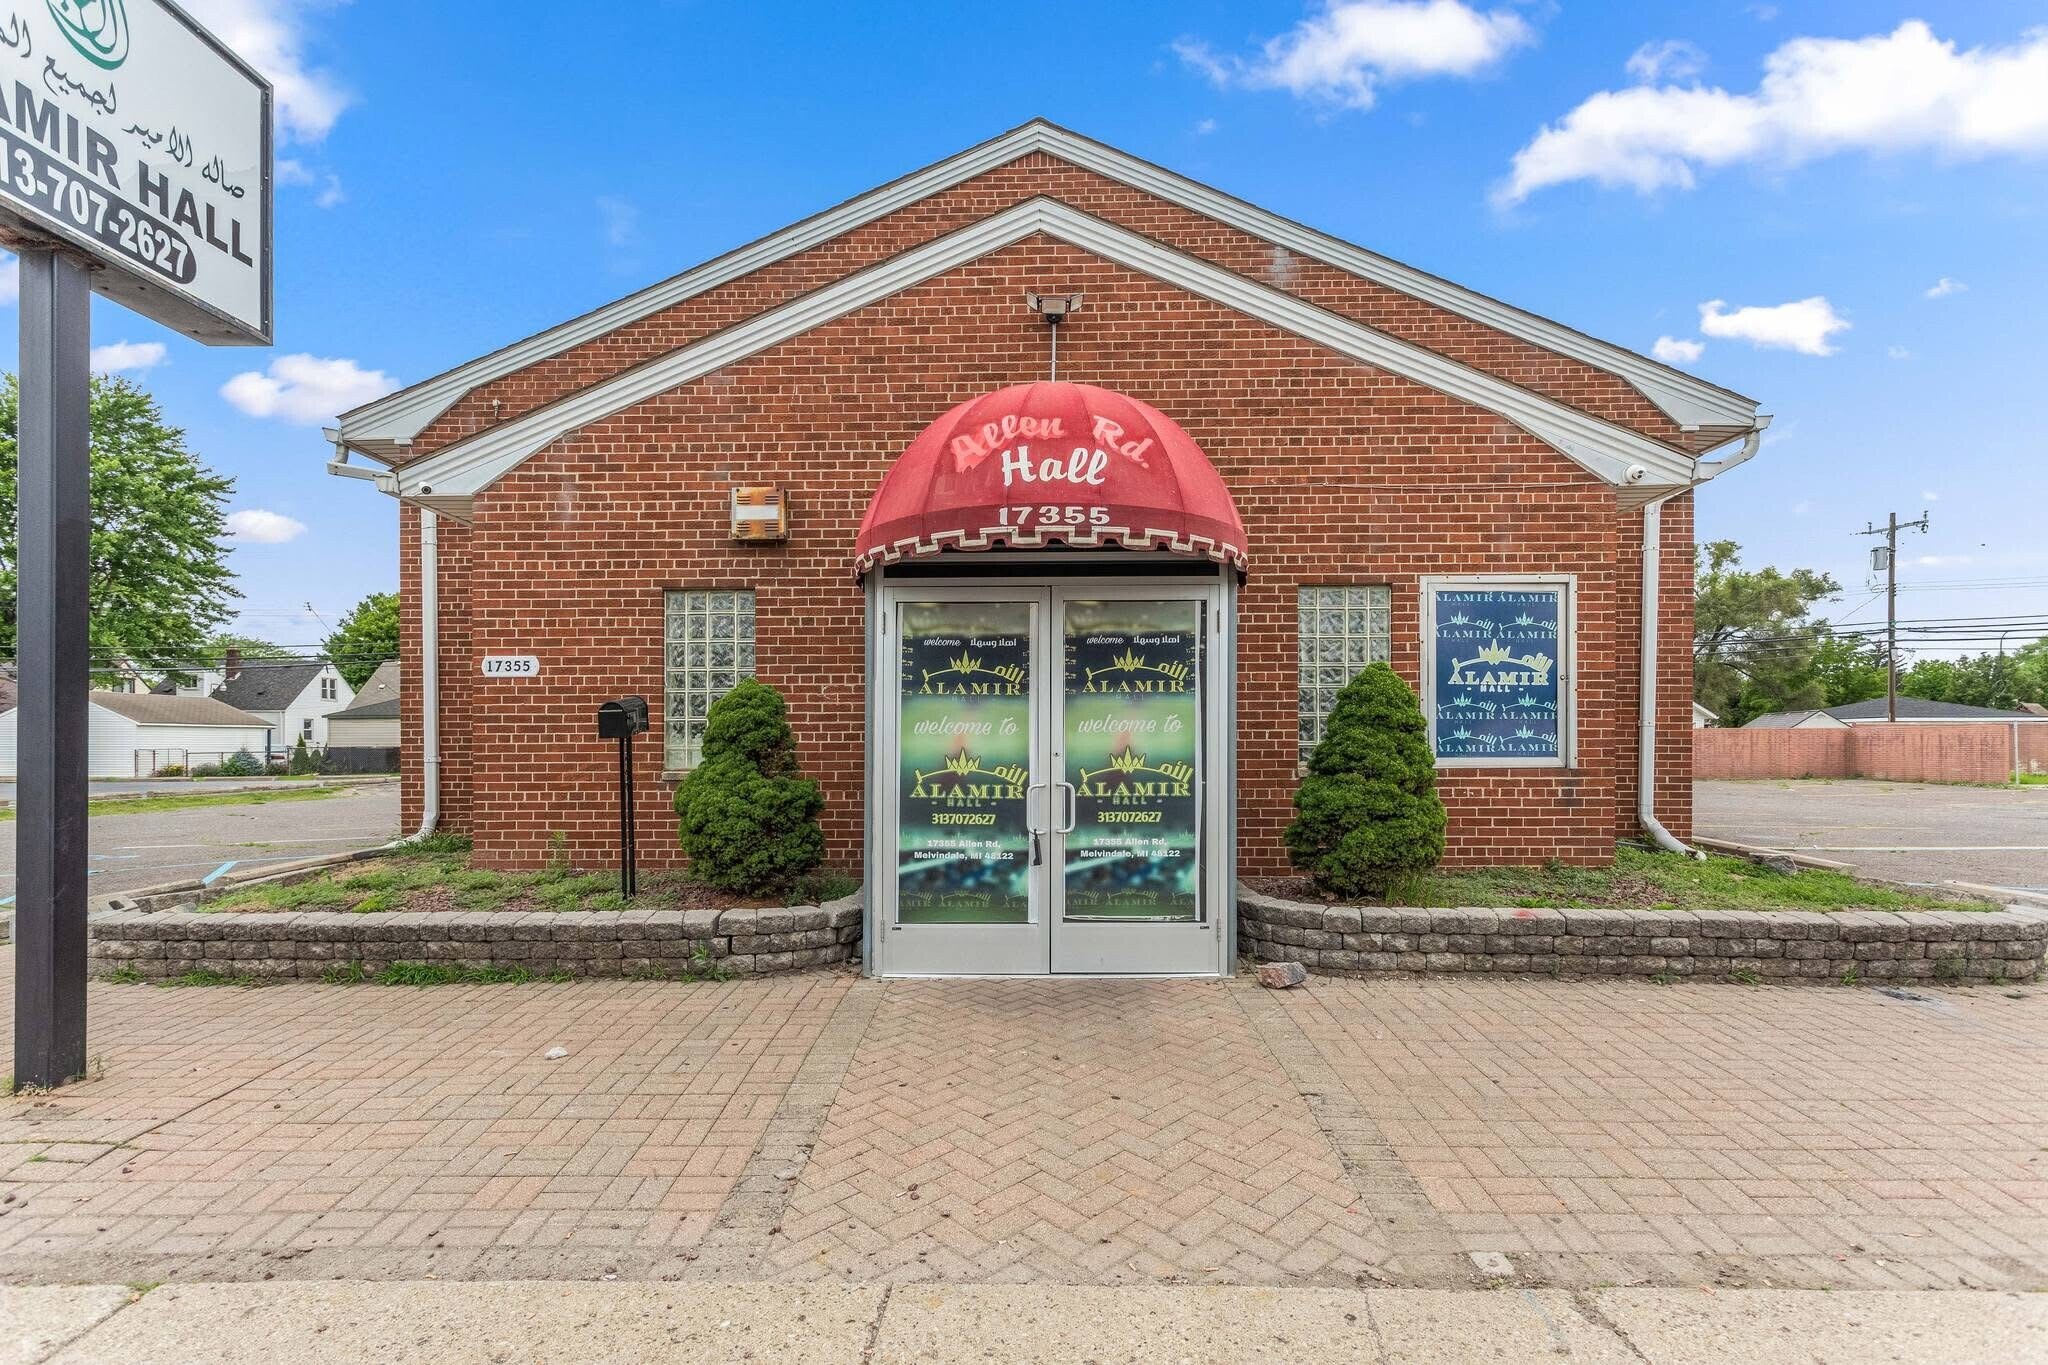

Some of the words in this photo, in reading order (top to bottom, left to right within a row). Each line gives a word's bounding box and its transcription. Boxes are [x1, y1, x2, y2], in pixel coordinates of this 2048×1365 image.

[139, 160, 253, 268] HALL
[951, 414, 1066, 474] Allen
[1001, 445, 1109, 488] Hall
[999, 506, 1111, 526] 17355
[923, 636, 961, 647] welcome
[1086, 634, 1125, 645] welcome
[487, 660, 531, 673] 17355
[1447, 670, 1550, 686] ALAMIR
[918, 682, 1021, 696] ALAMIR
[1082, 680, 1185, 693] ALAMIR
[914, 715, 993, 736] welcome
[998, 716, 1019, 736] to
[1078, 713, 1157, 734] welcome
[1163, 713, 1184, 733] to
[909, 783, 1025, 799] ALAMIR
[1076, 781, 1191, 797] ALAMIR
[931, 813, 997, 825] 3137072627
[1097, 811, 1163, 823] 3137072627
[970, 852, 983, 860] MI
[1137, 850, 1149, 858] MI
